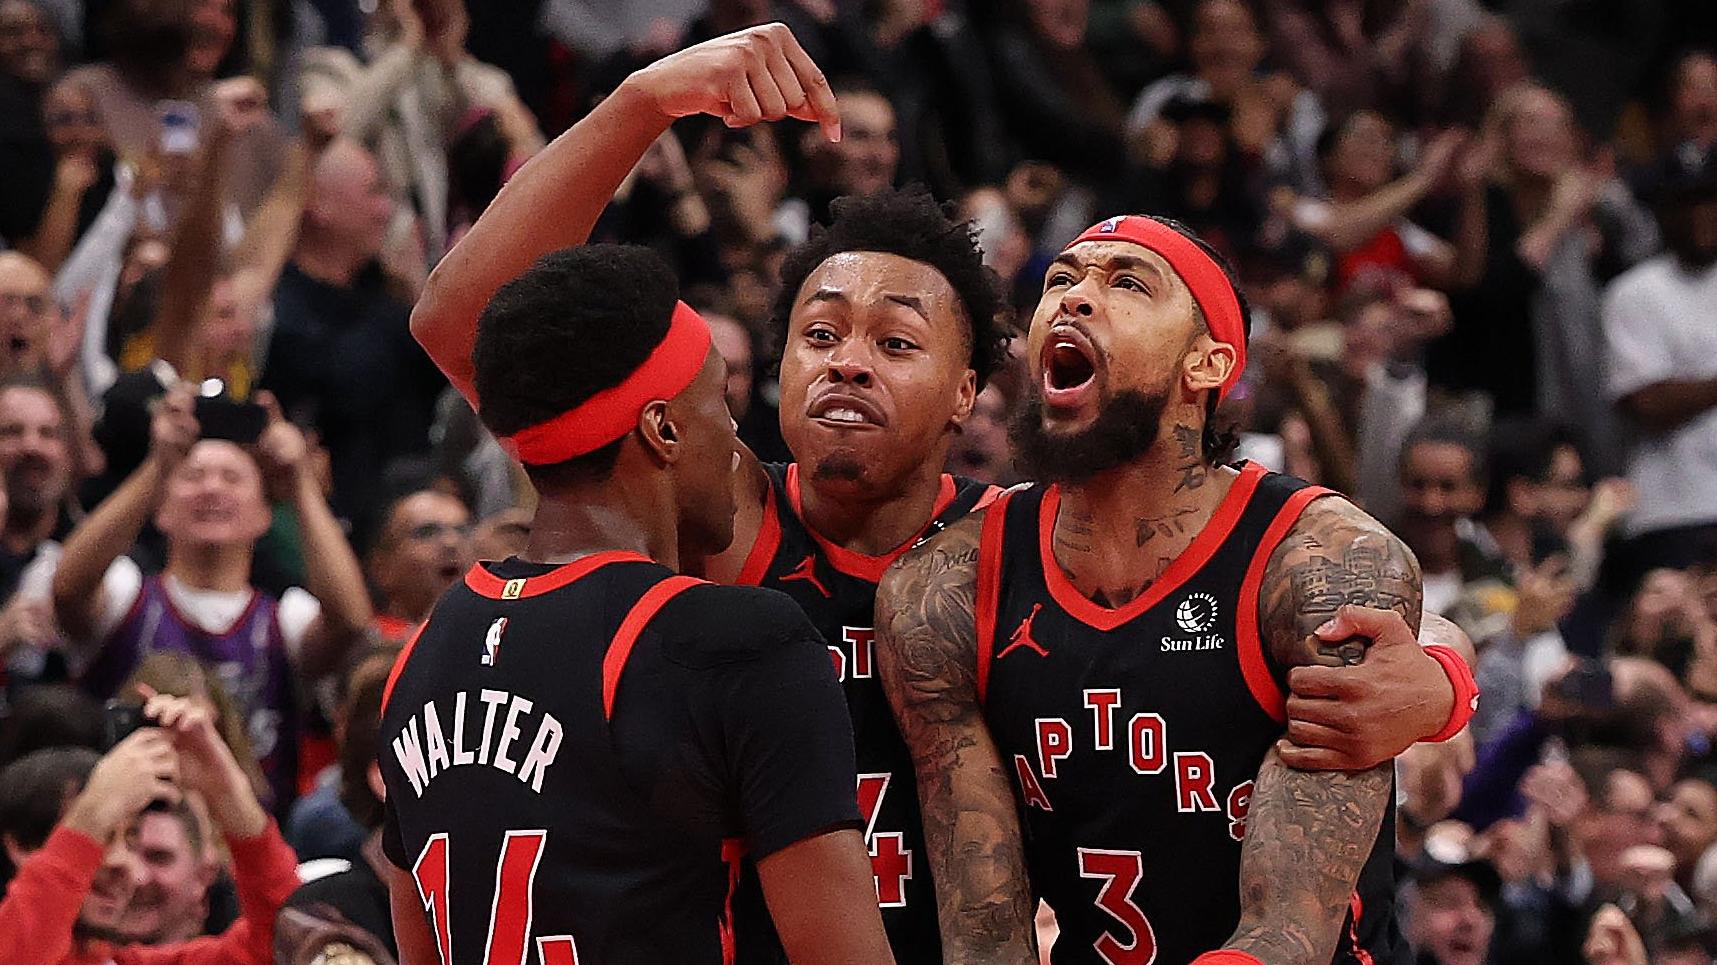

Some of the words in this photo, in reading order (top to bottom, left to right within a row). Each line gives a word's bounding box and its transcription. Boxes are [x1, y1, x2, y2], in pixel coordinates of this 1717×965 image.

[1160, 636, 1192, 652] Sun
[1195, 633, 1225, 650] Life
[392, 689, 563, 798] WALTER
[1077, 847, 1157, 965] 3
